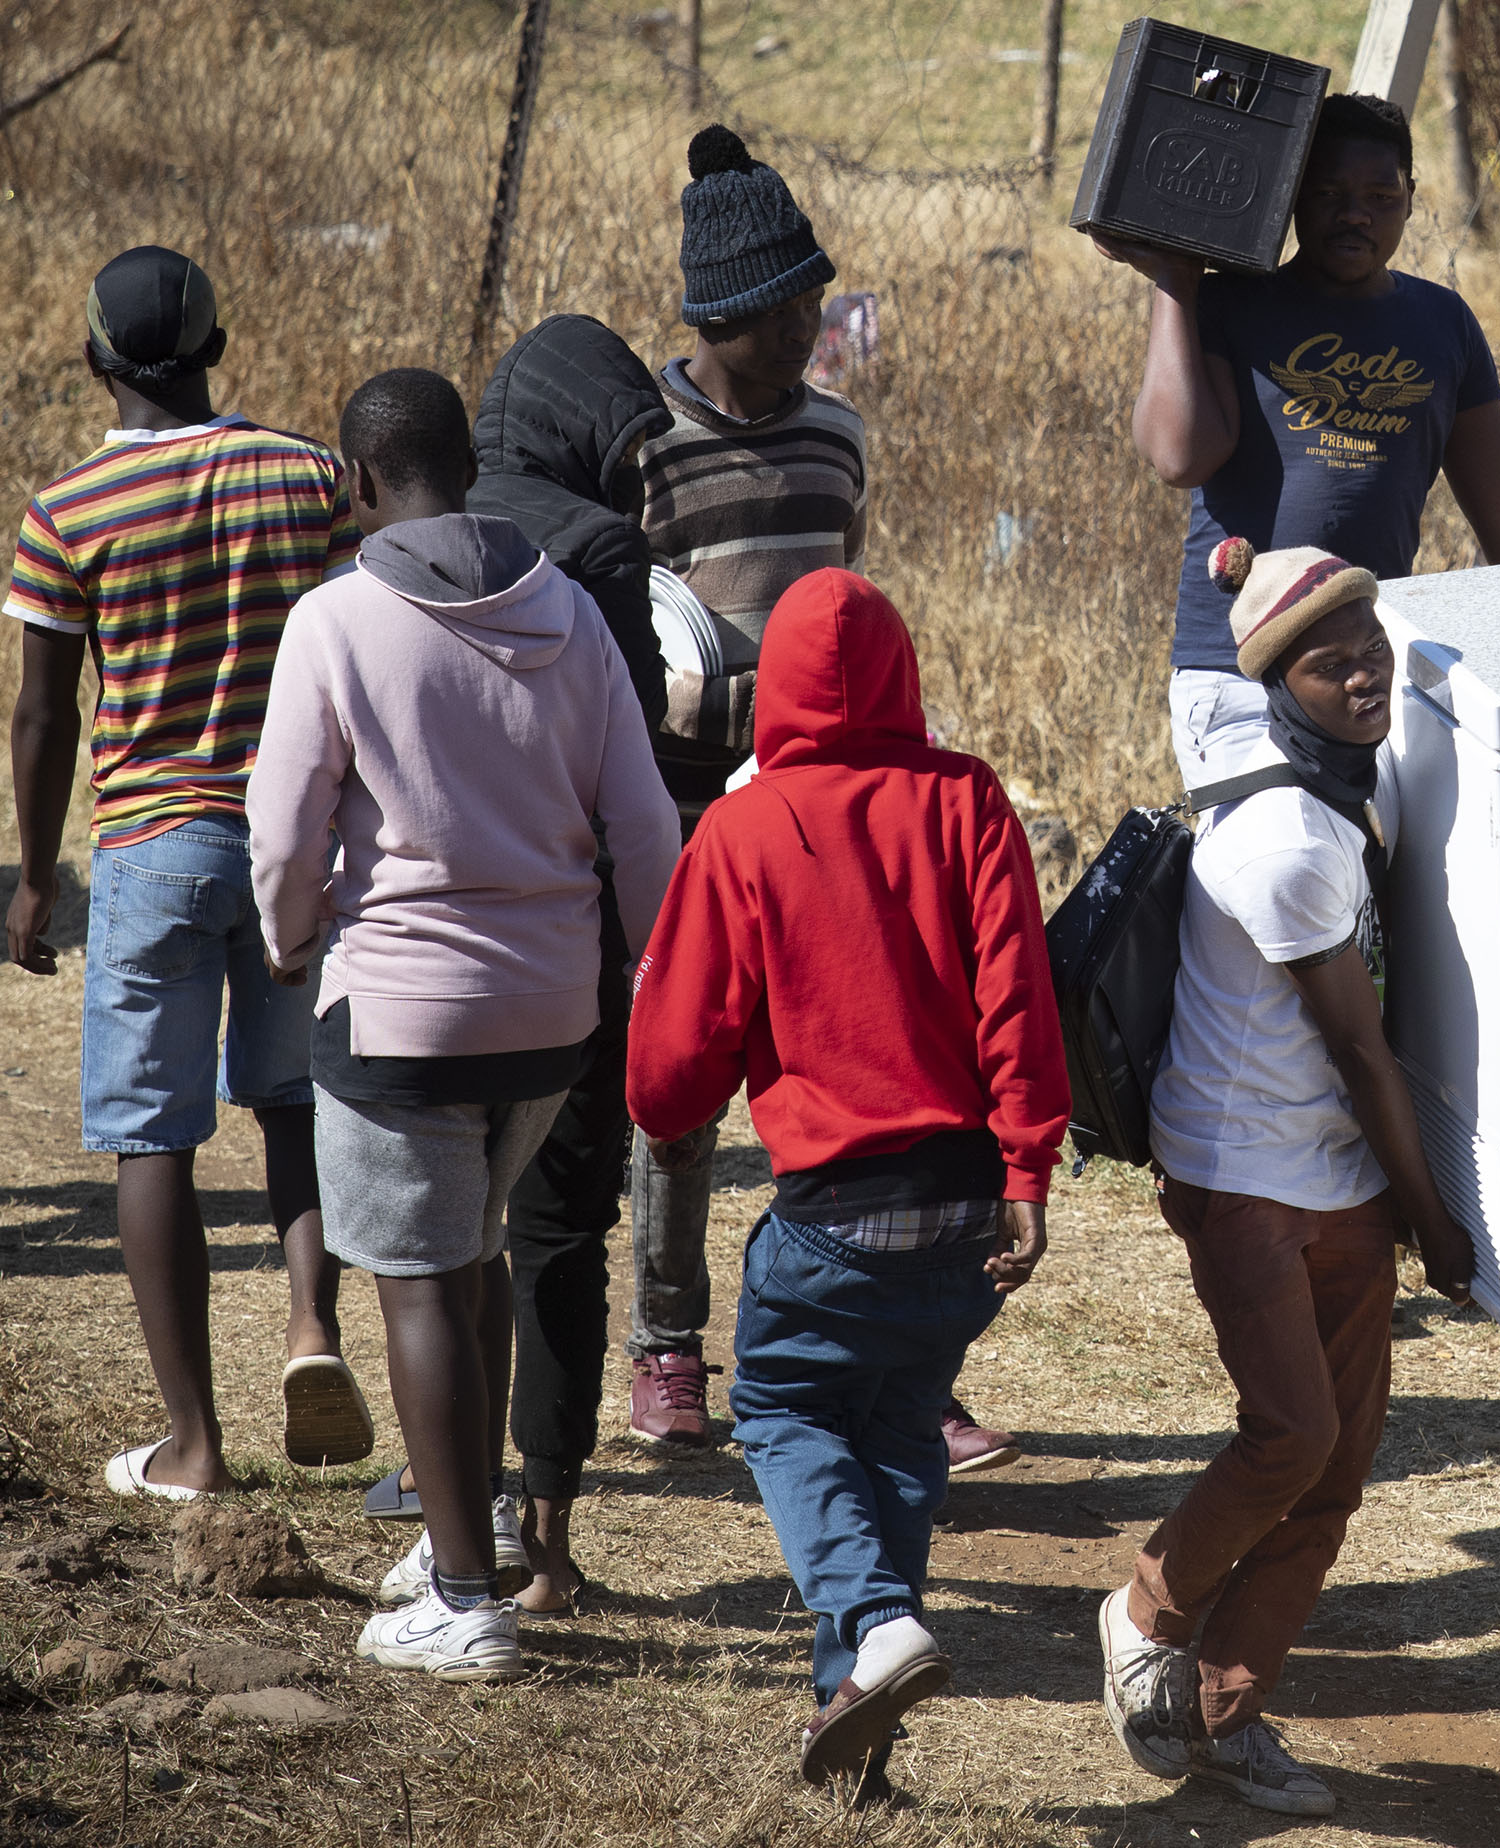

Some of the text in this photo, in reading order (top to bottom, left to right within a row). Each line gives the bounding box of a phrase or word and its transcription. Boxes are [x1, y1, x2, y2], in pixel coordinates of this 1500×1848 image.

[1163, 138, 1244, 187] SAB
[1157, 170, 1234, 206] MILLER
[1286, 333, 1425, 384] Code
[1282, 392, 1412, 435] Denim
[1305, 447, 1342, 460] AUTHENTIC
[1320, 432, 1377, 452] PREMIUM
[641, 954, 654, 972] I'd
